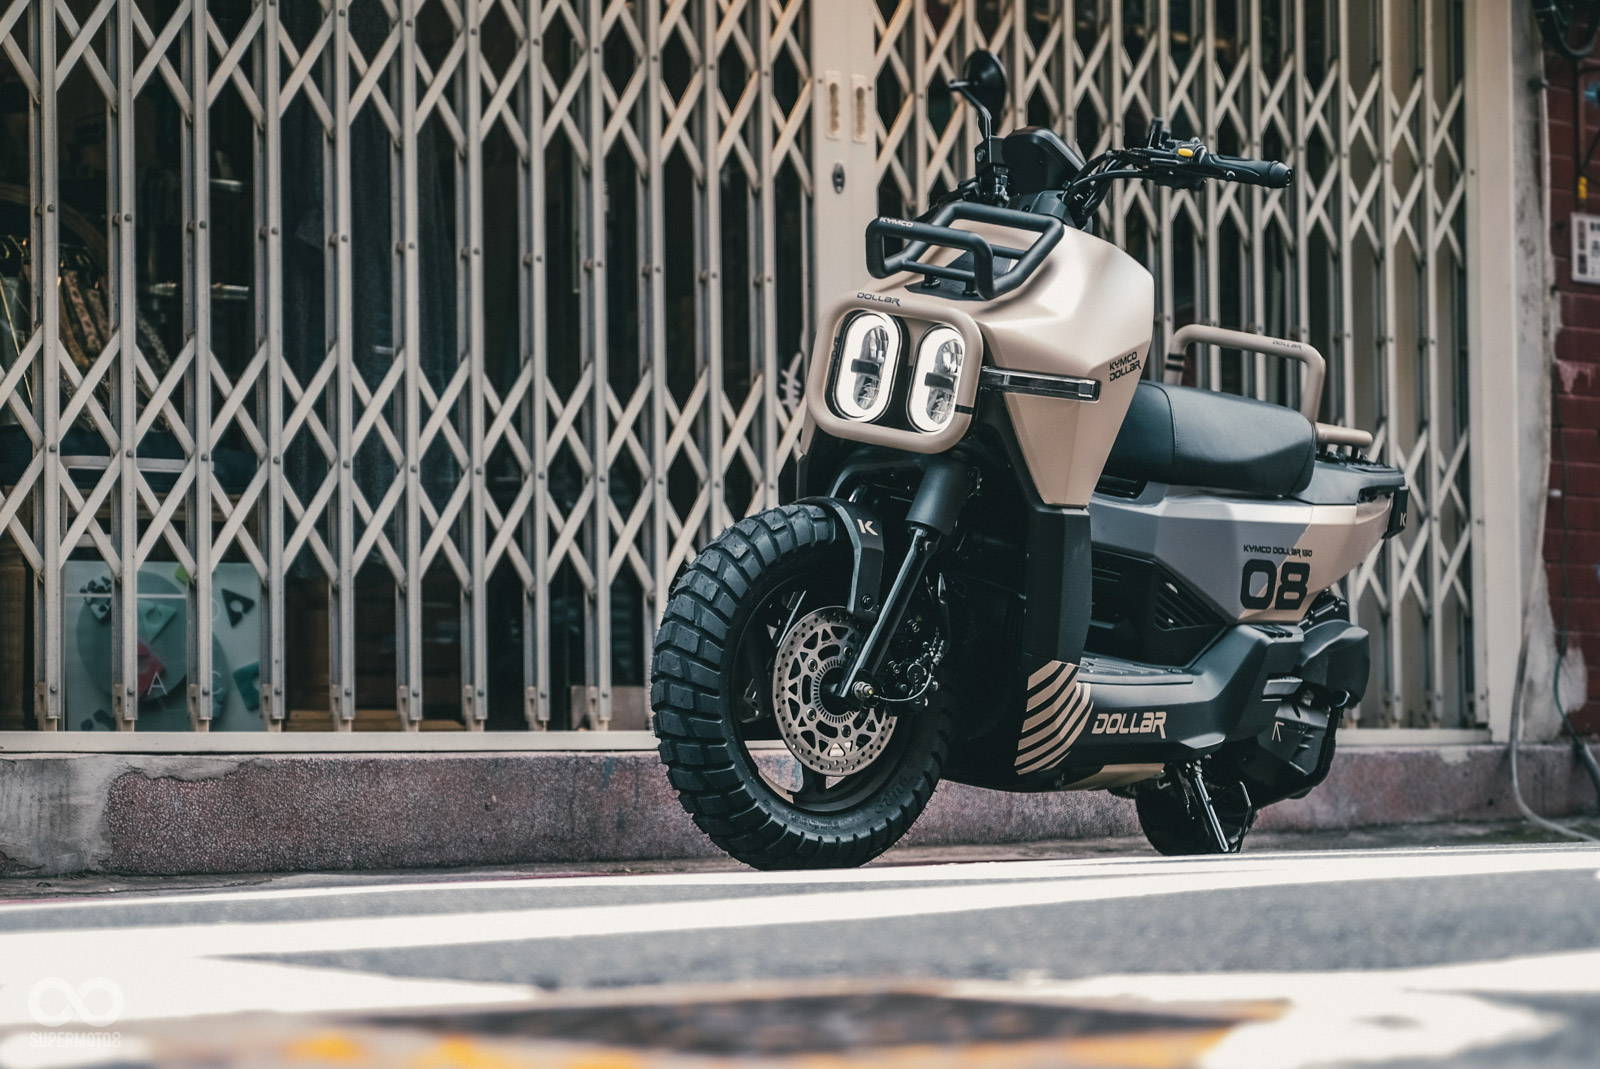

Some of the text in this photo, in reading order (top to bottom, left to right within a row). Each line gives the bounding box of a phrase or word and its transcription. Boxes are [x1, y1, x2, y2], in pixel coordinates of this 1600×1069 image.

[880, 217, 914, 228] KYMCO
[857, 292, 900, 307] DOLLAR
[1109, 351, 1138, 371] KYMCO
[1109, 360, 1142, 382] DOLLAR
[1243, 544, 1271, 554] KYMCO
[1273, 546, 1301, 558] DOLLAR
[1240, 559, 1310, 610] 08
[1091, 711, 1167, 739] DOLLAR
